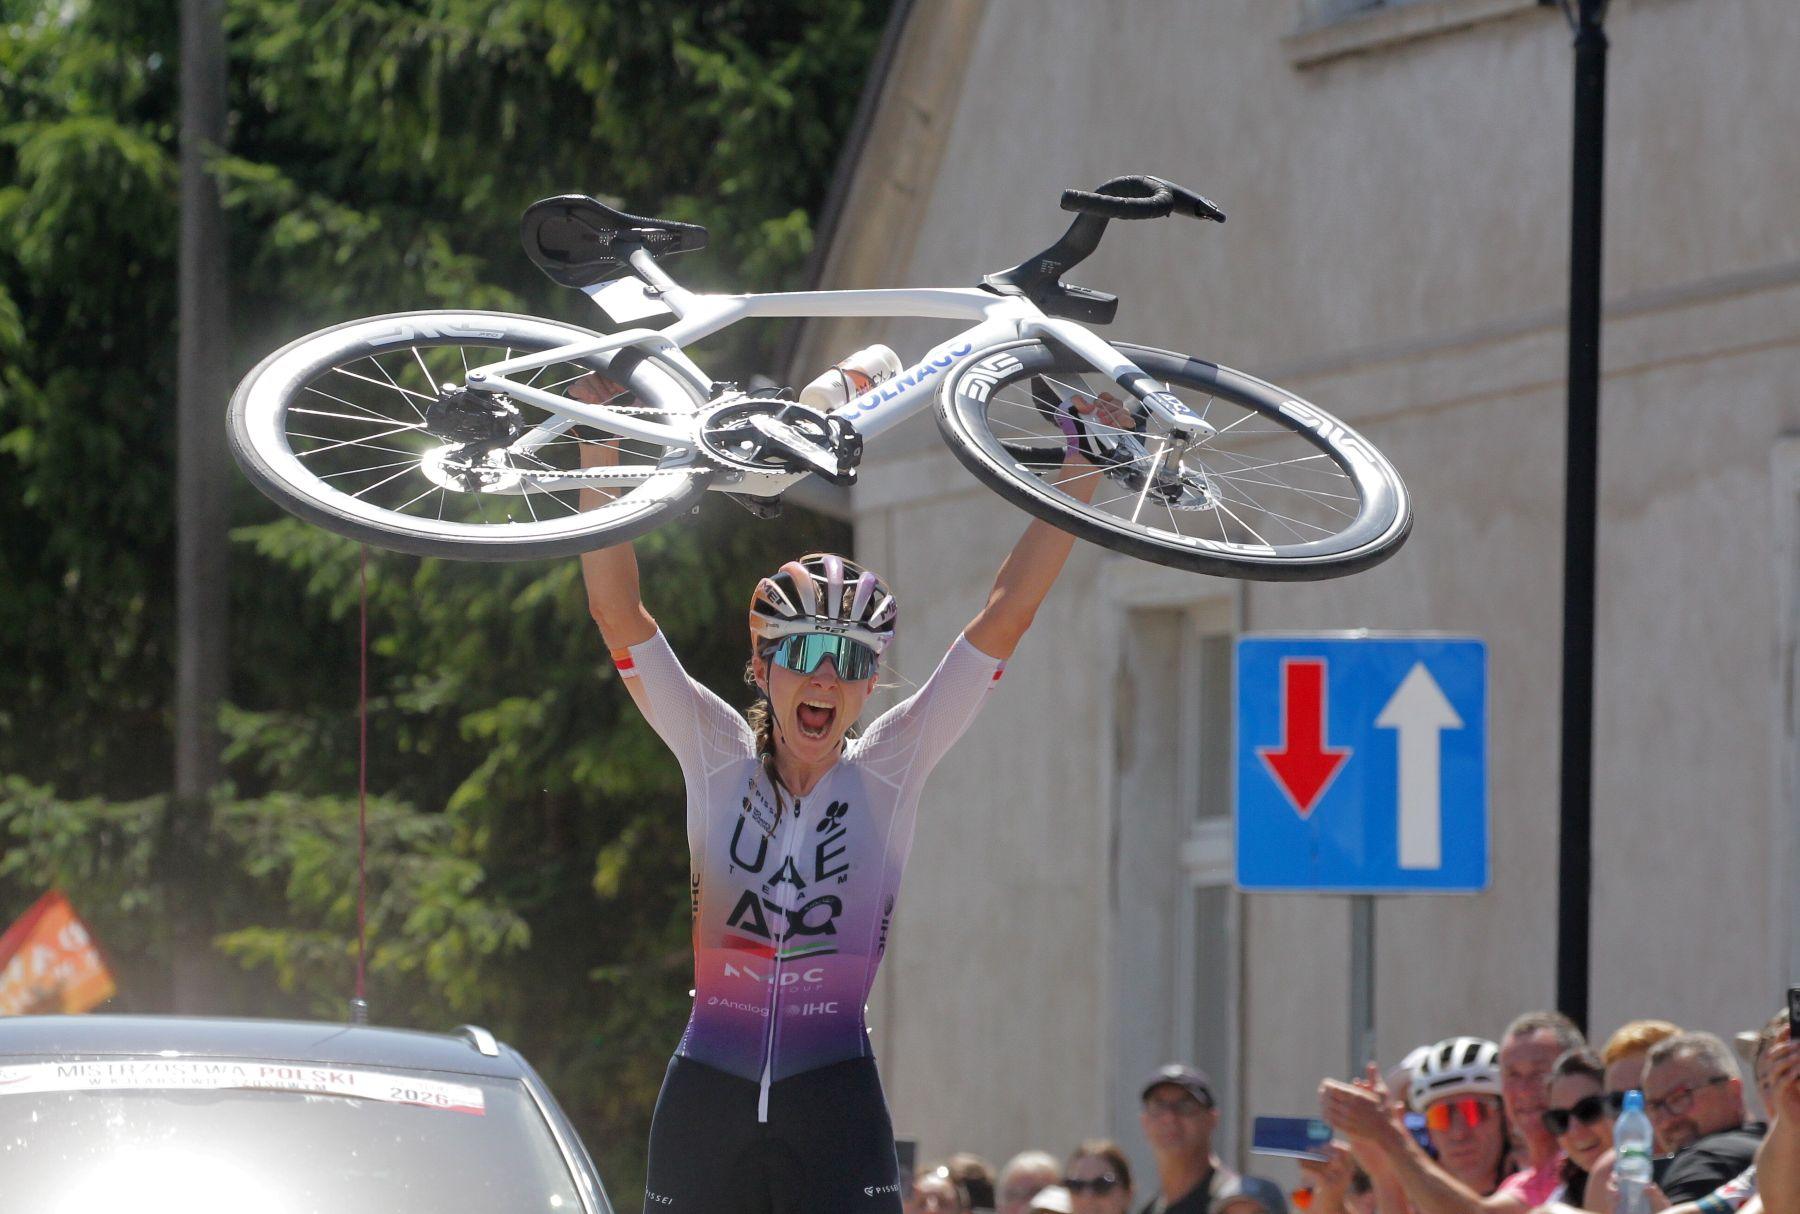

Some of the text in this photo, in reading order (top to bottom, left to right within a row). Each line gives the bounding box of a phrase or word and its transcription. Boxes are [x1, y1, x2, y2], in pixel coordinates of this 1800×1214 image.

[760, 579, 789, 607] MET
[814, 624, 849, 635] MET
[729, 813, 850, 890] UAE
[725, 888, 843, 943] ADQ
[719, 997, 770, 1017] Analog
[802, 1001, 838, 1016] IHC
[259, 1065, 356, 1086] POLSKI
[389, 1086, 449, 1106] 2026
